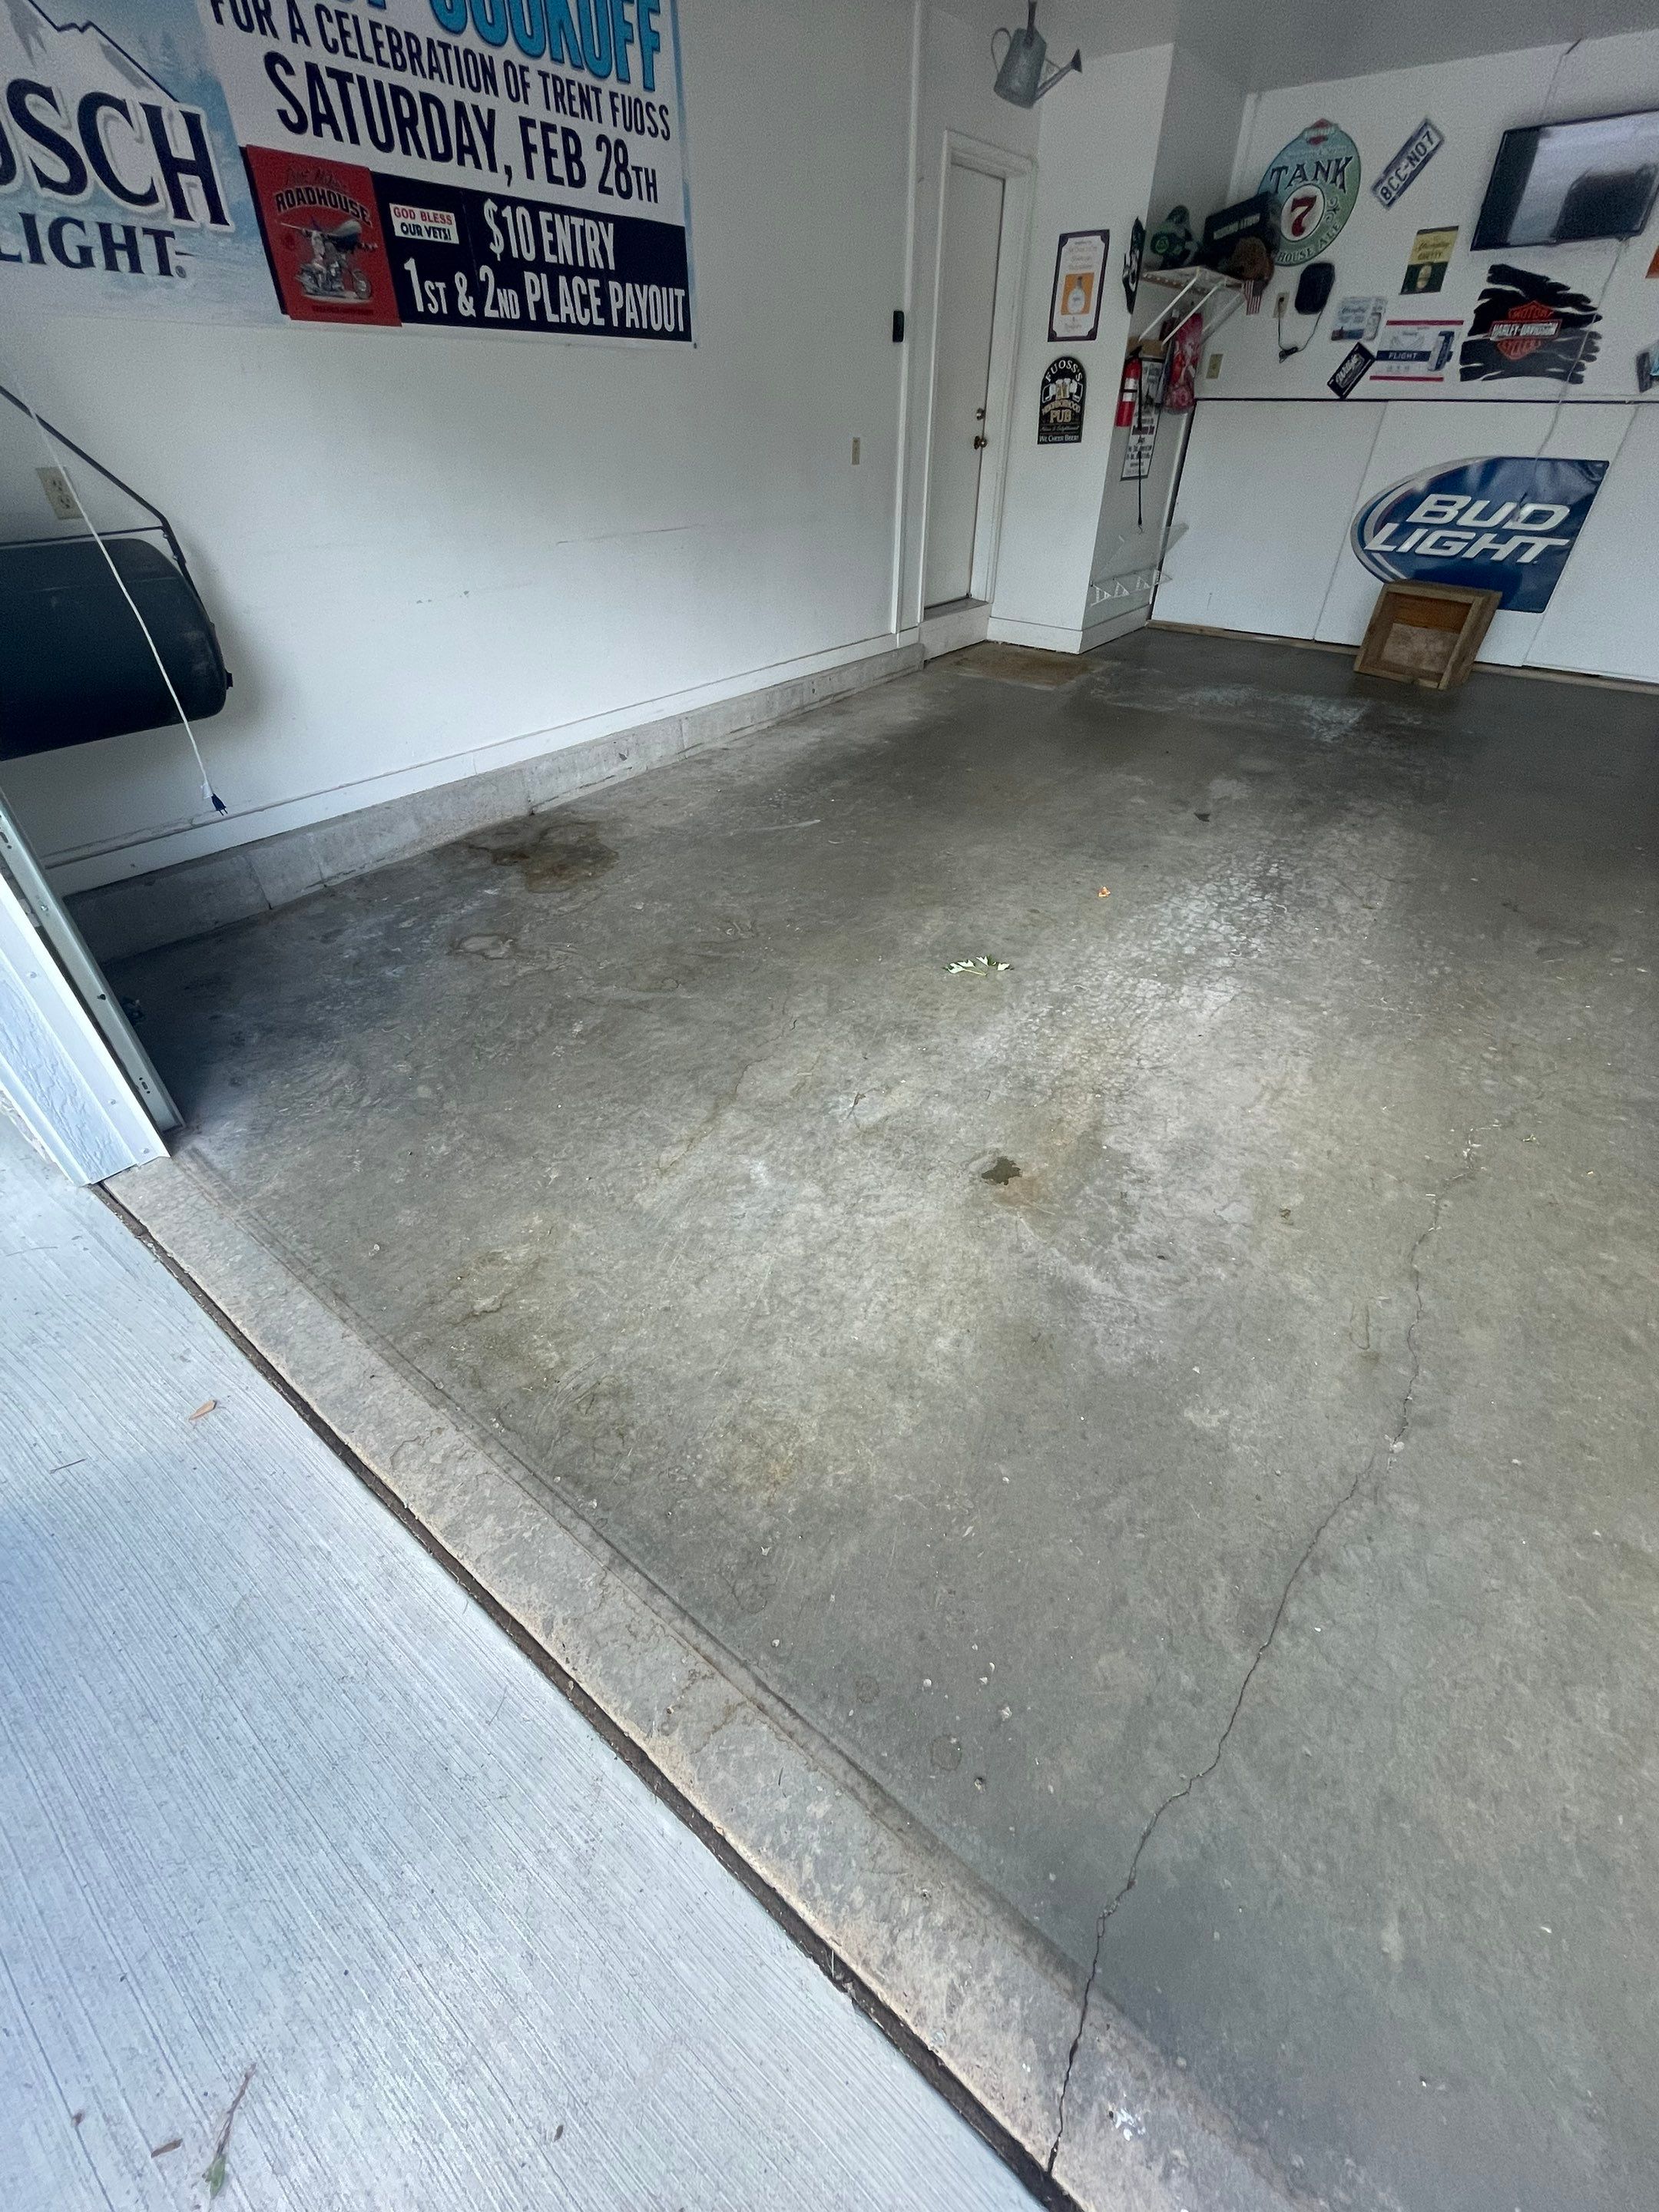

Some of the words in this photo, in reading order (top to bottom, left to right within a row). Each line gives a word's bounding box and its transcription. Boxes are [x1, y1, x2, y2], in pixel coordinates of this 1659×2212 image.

[286, 0, 312, 47] A
[314, 3, 499, 98] CELEBRATION
[503, 60, 530, 105] OF
[537, 70, 603, 124] TRENT
[609, 91, 671, 141] FUOSS
[263, 50, 513, 187] SATURDAY,
[518, 115, 587, 189] FEB
[595, 134, 659, 204] 28TH
[1270, 156, 1353, 194] TANK
[273, 185, 373, 228] ROADHOUSE
[392, 207, 416, 220] GOD
[420, 210, 453, 226] BLESS
[1290, 195, 1317, 237] 7
[400, 222, 423, 237] OUR
[425, 226, 452, 241] VETS!
[483, 198, 535, 261] $10
[538, 211, 615, 270] ENTRY
[403, 257, 448, 314] 1ST
[454, 271, 476, 318] &
[479, 265, 521, 320] 2ND
[523, 270, 605, 326] PLACE
[608, 281, 686, 333] PAYOUT
[1045, 360, 1082, 382] FUOSS'S
[1049, 409, 1072, 423] PUB
[1406, 494, 1570, 531] BUD
[1364, 523, 1570, 562] LIGHT
